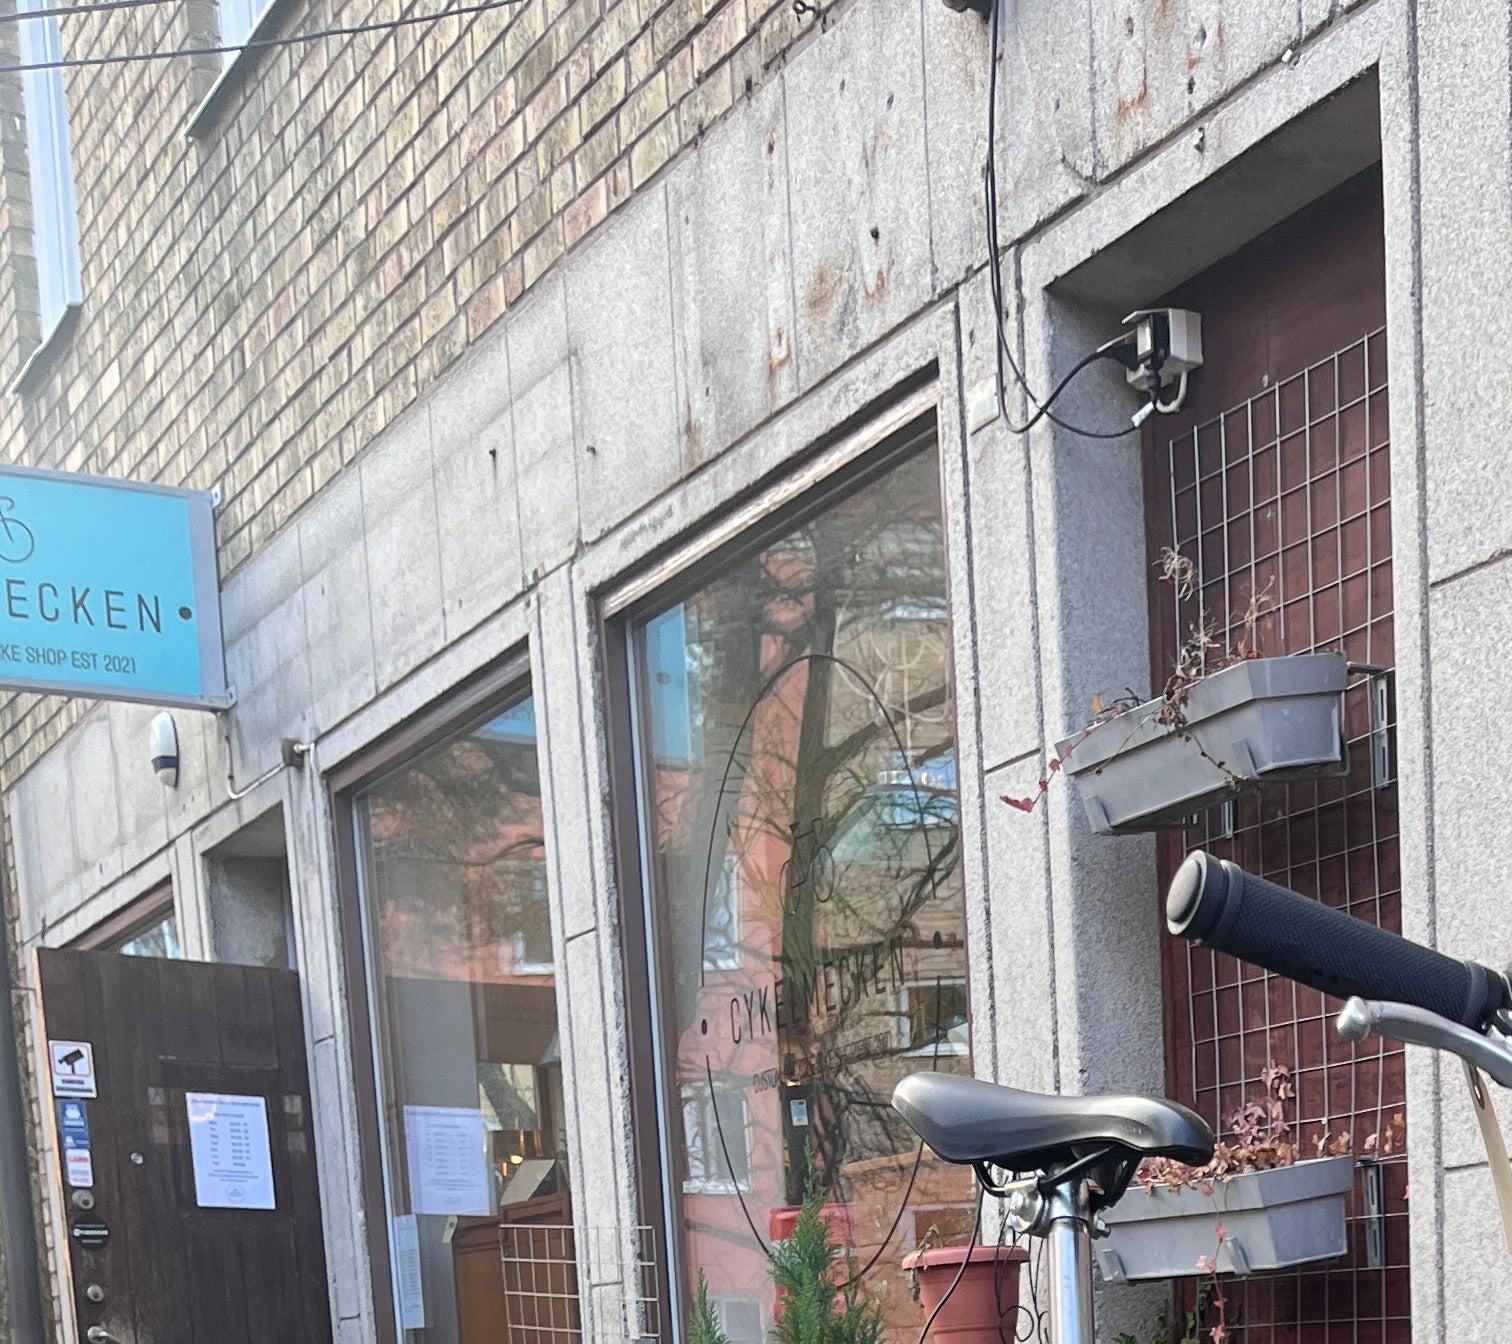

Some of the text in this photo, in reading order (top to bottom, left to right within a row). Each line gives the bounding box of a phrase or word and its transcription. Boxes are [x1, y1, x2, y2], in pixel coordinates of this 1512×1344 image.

[25, 645, 67, 667] SHOP
[71, 650, 98, 670] EST
[103, 654, 137, 675] 2021
[730, 937, 904, 1045] CYKELMECKEN
